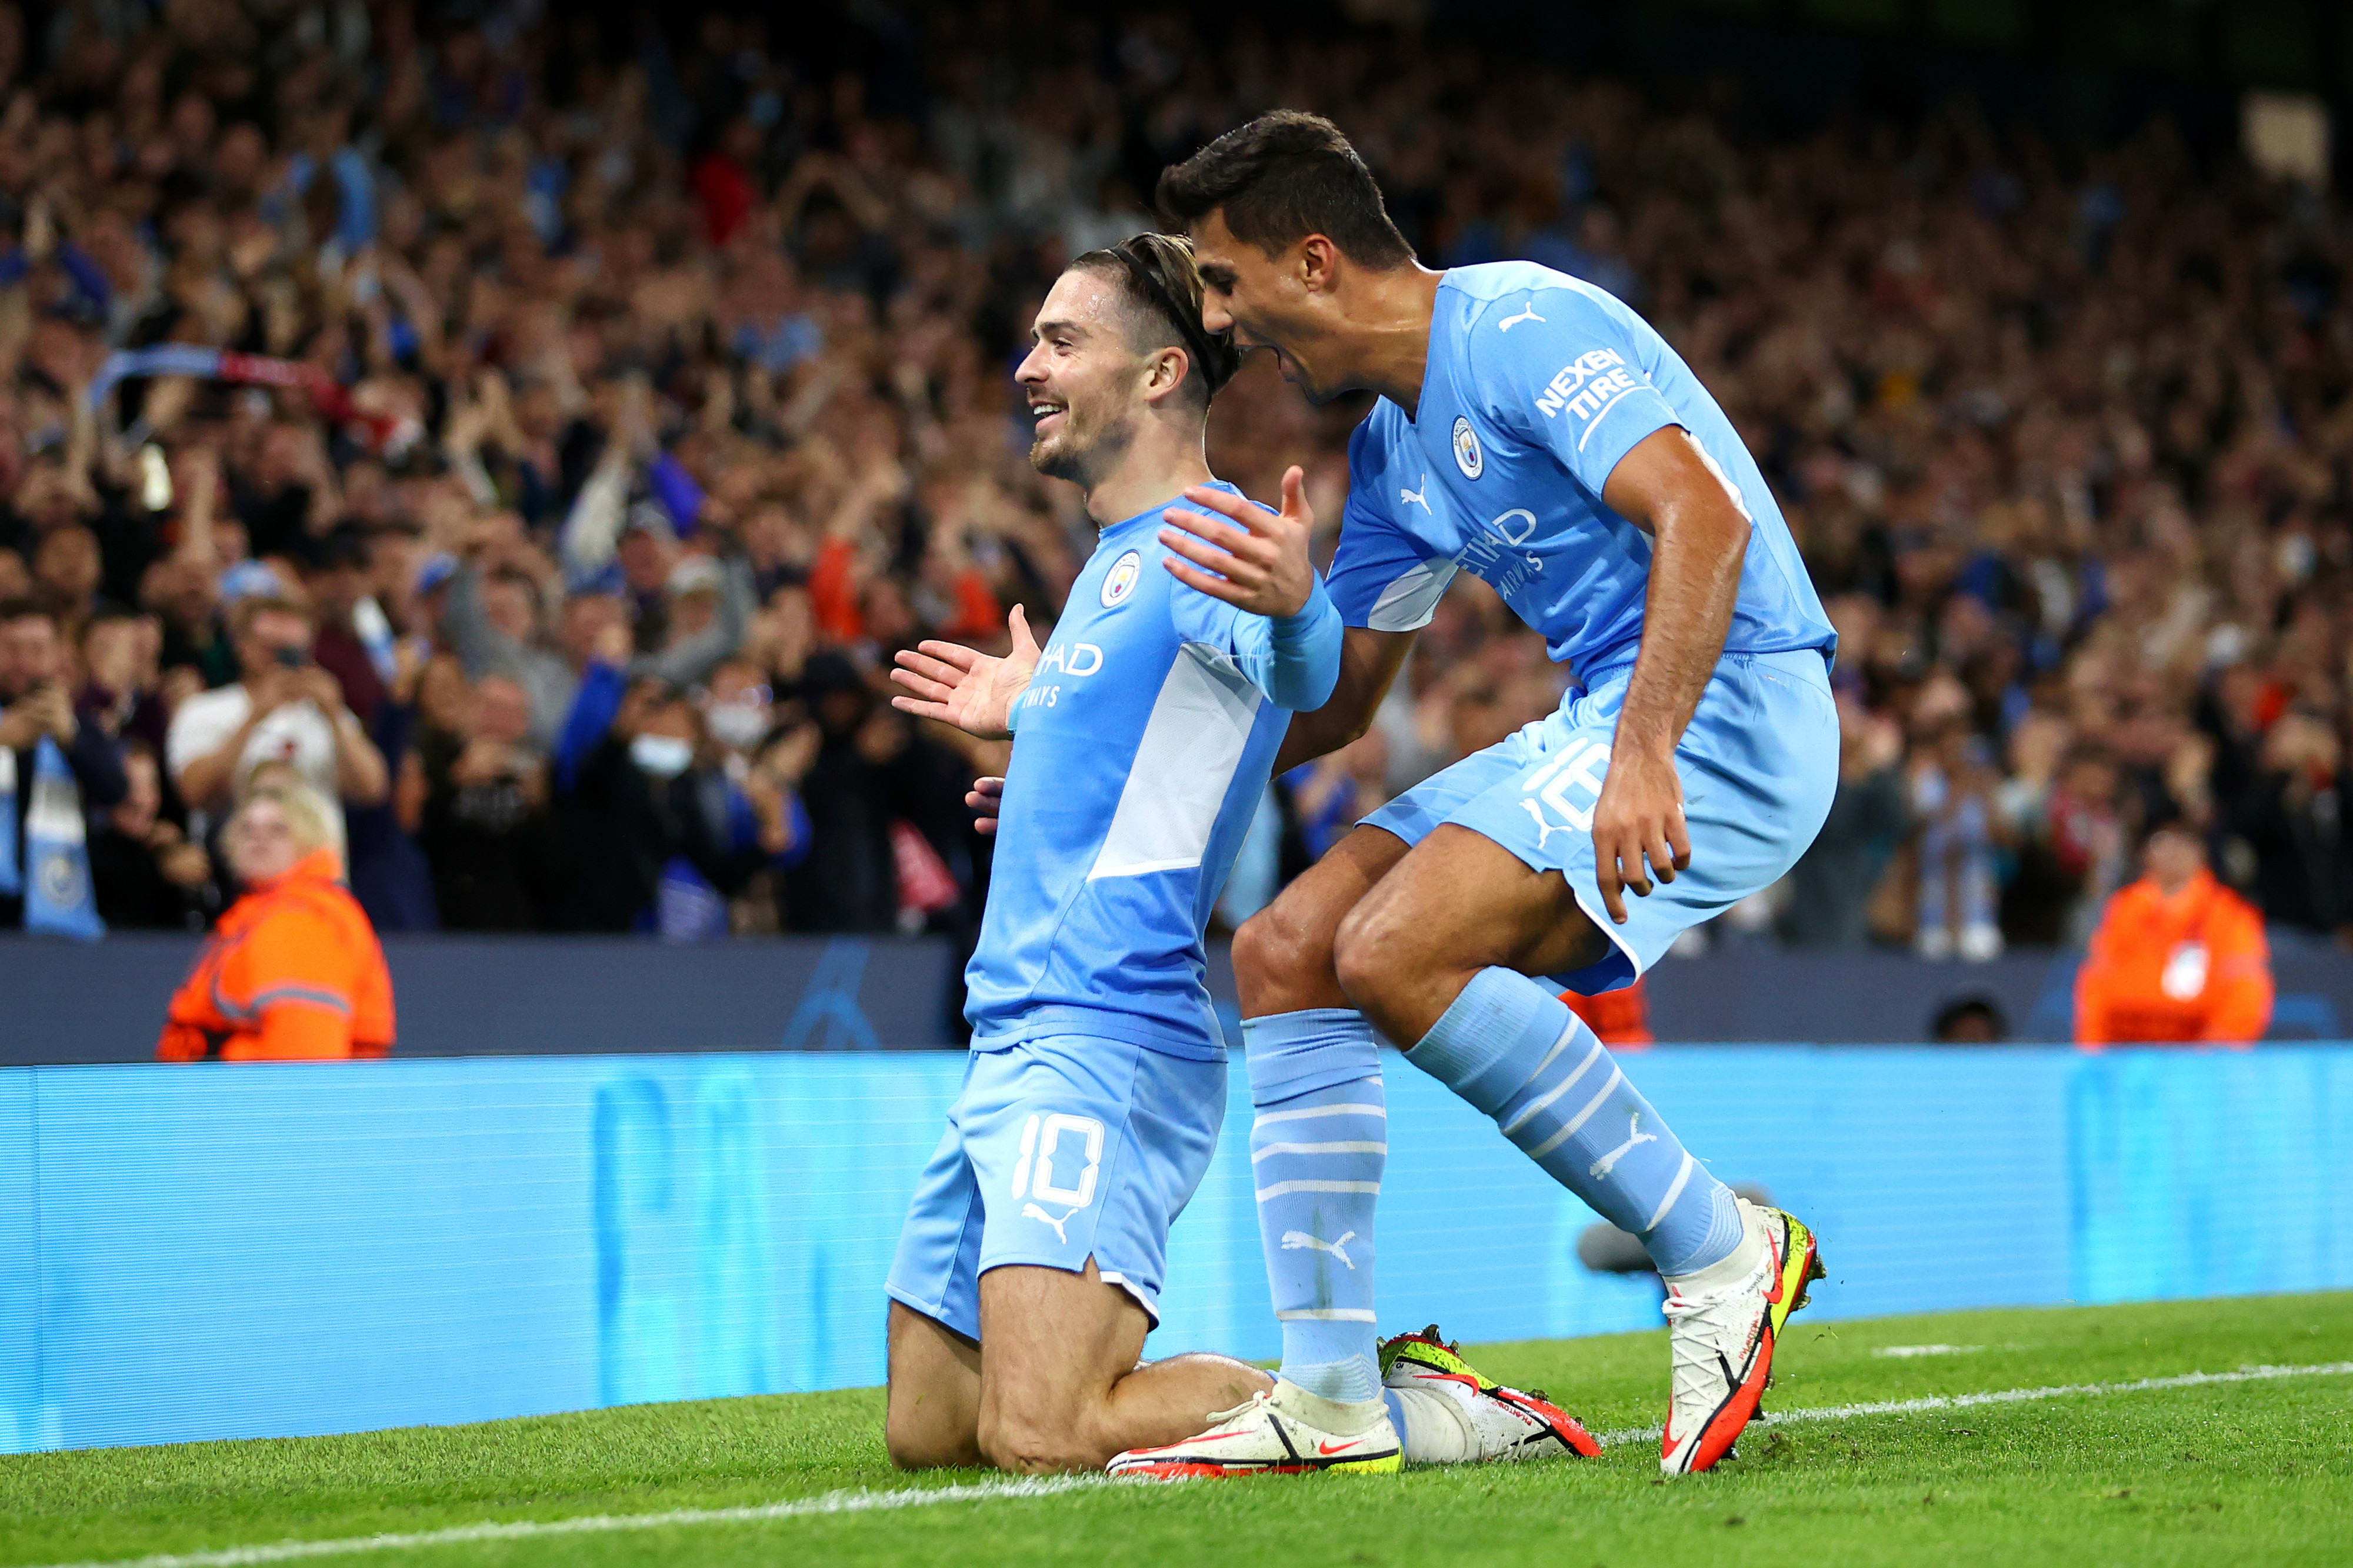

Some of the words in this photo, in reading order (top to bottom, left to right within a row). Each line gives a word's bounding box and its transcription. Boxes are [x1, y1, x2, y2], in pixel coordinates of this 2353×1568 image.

[1535, 348, 1626, 418] NEXEN
[1565, 367, 1635, 420] TIRE
[1500, 550, 1543, 600] AIRWAS
[1034, 643, 1104, 676] HAD
[1011, 1113, 1105, 1207] 10
[1495, 1400, 1532, 1426] PHANTOM
